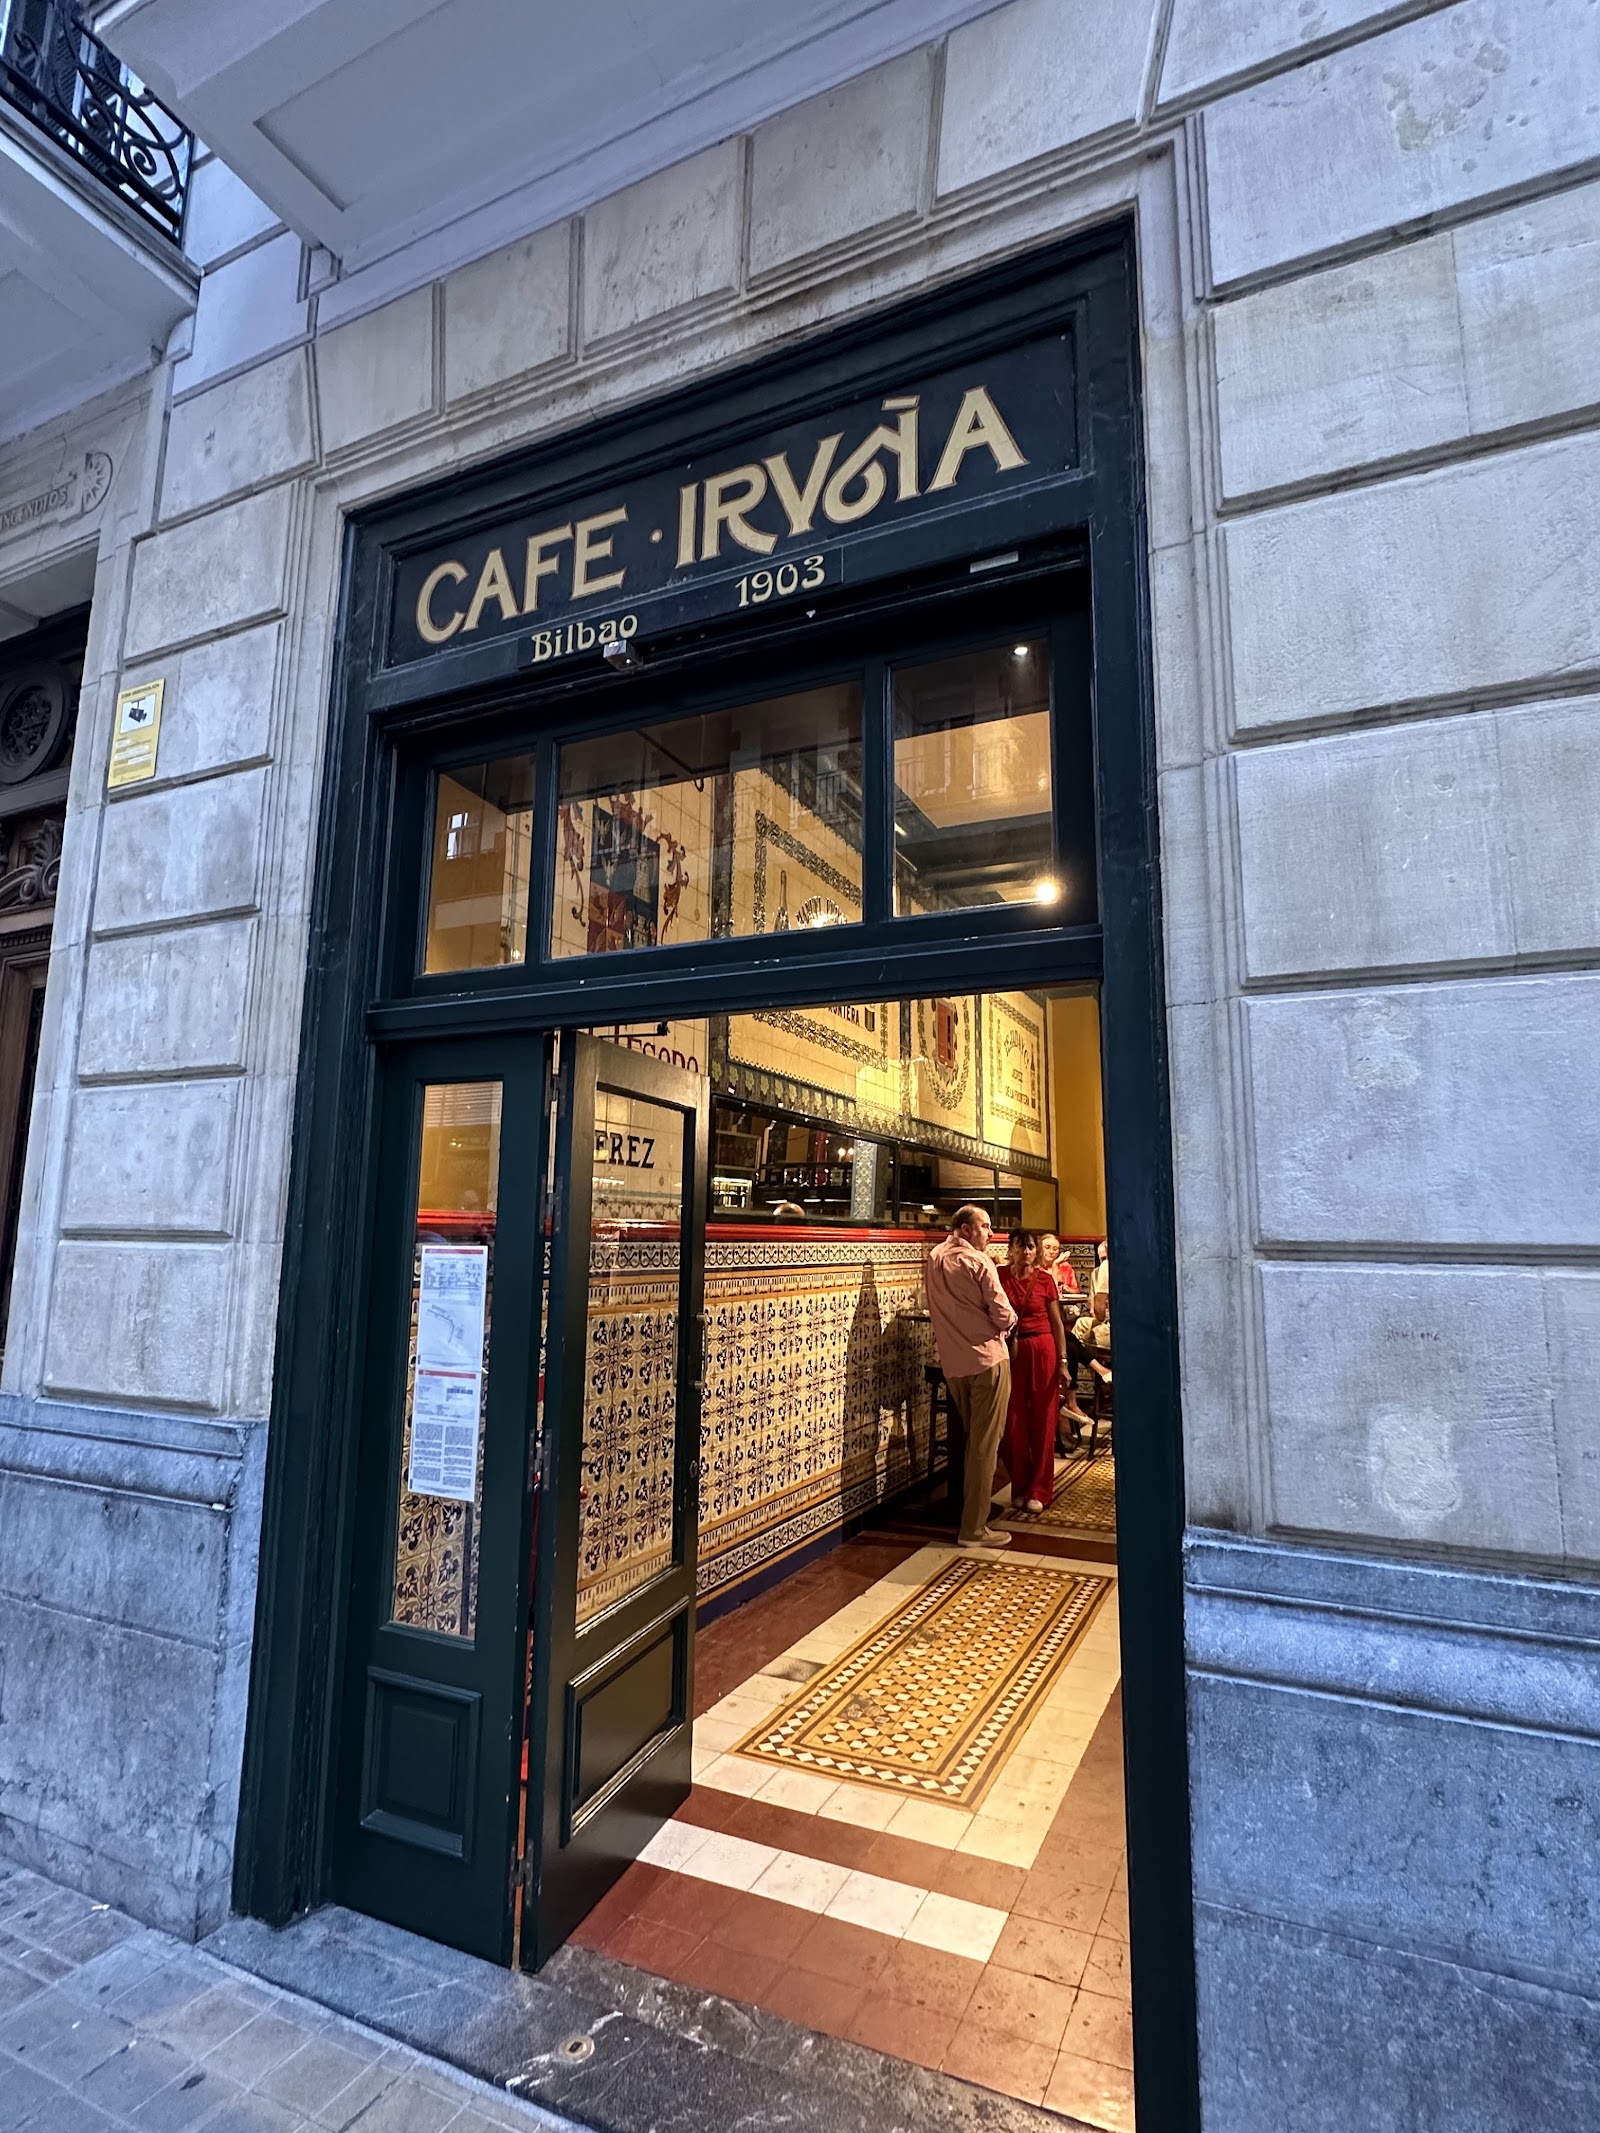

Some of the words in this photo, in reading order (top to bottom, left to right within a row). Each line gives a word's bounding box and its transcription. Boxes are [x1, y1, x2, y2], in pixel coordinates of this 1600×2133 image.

[415, 505, 628, 645] CAFE
[735, 555, 825, 608] 1903
[531, 614, 638, 663] Bilbao
